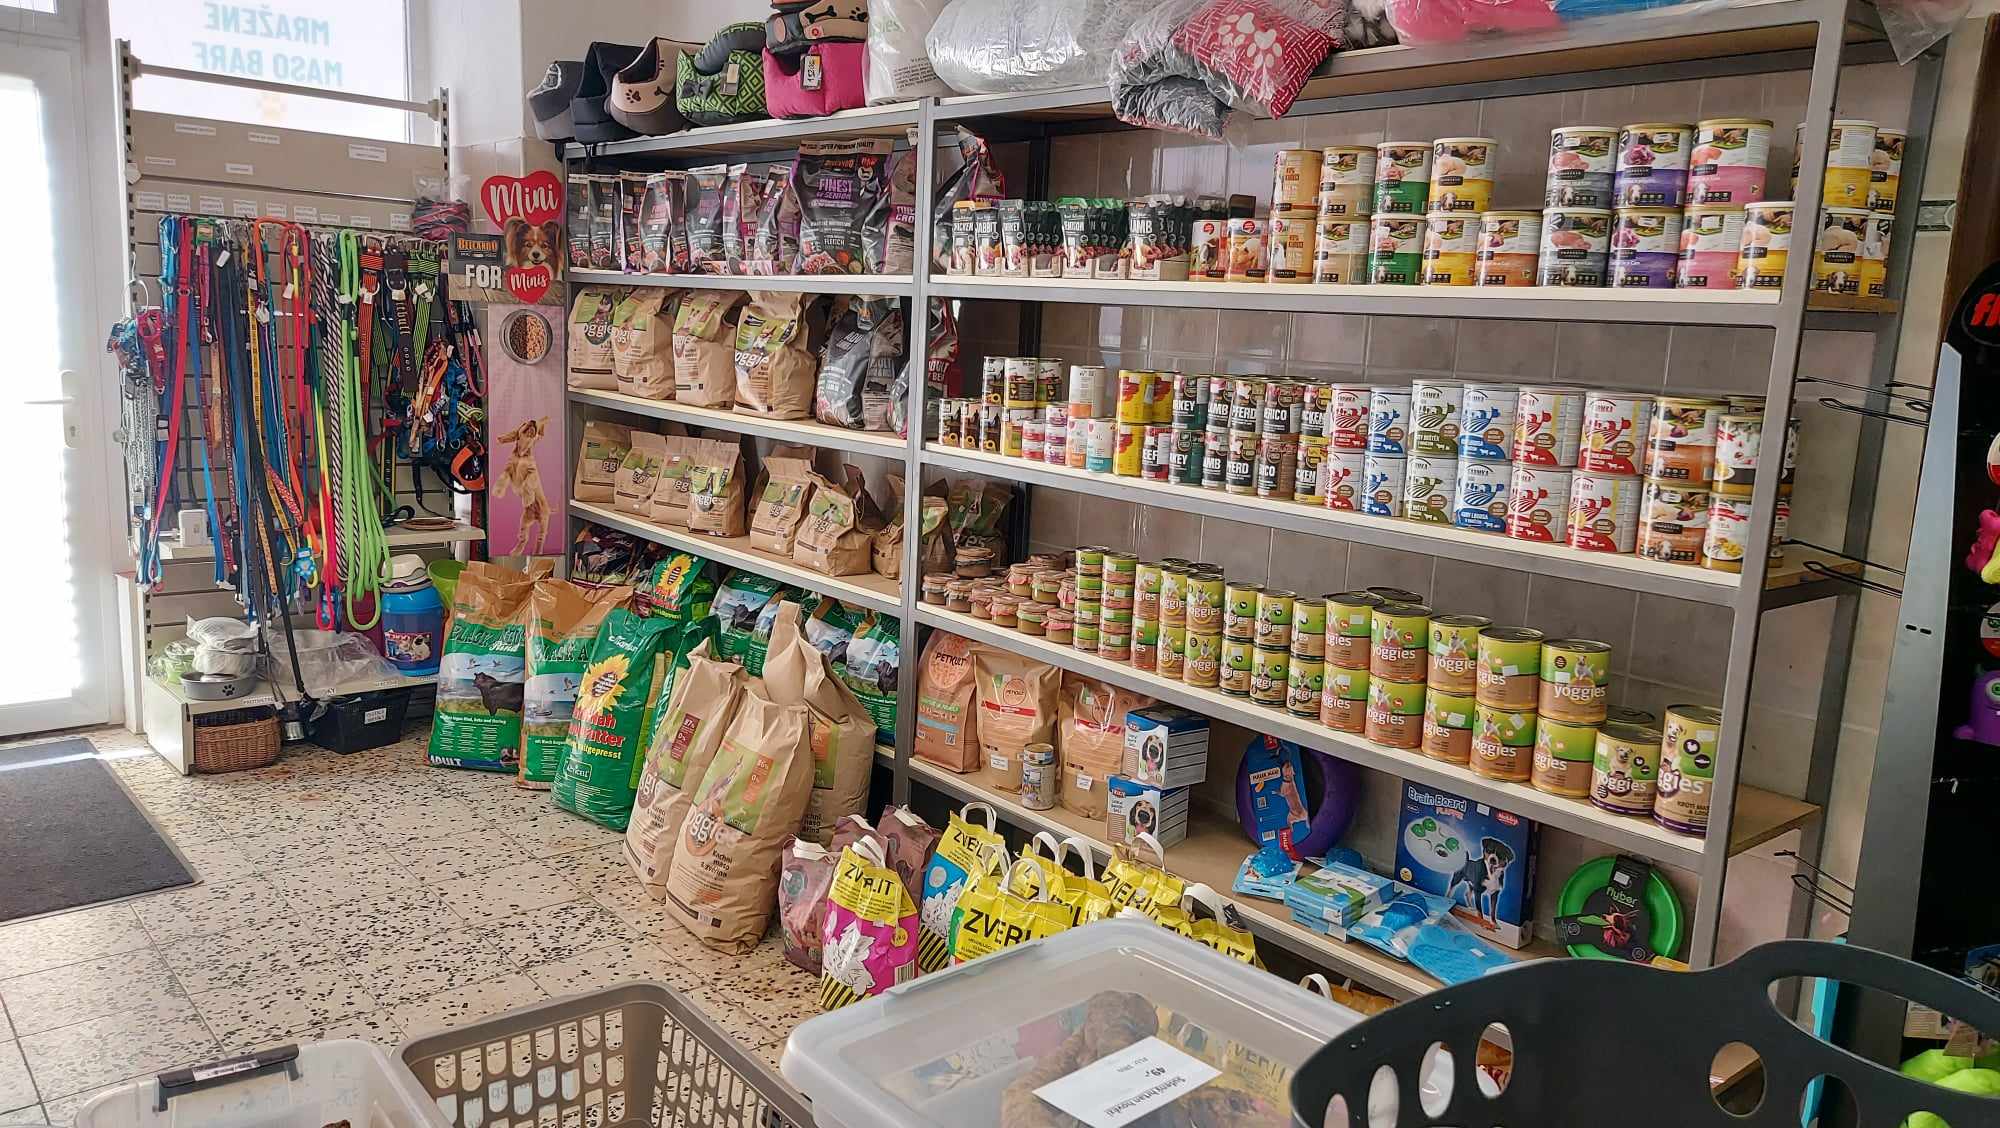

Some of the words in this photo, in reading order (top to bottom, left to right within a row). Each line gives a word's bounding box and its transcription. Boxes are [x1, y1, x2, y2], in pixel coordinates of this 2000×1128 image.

[817, 178, 853, 193] FINEST
[490, 181, 558, 221] Mini
[465, 263, 502, 289] FOR
[510, 272, 547, 292] Minis
[935, 651, 967, 667] PETKULT
[1554, 683, 1606, 701] yoggies
[1408, 786, 1435, 806] Brain
[1435, 794, 1467, 813] Board
